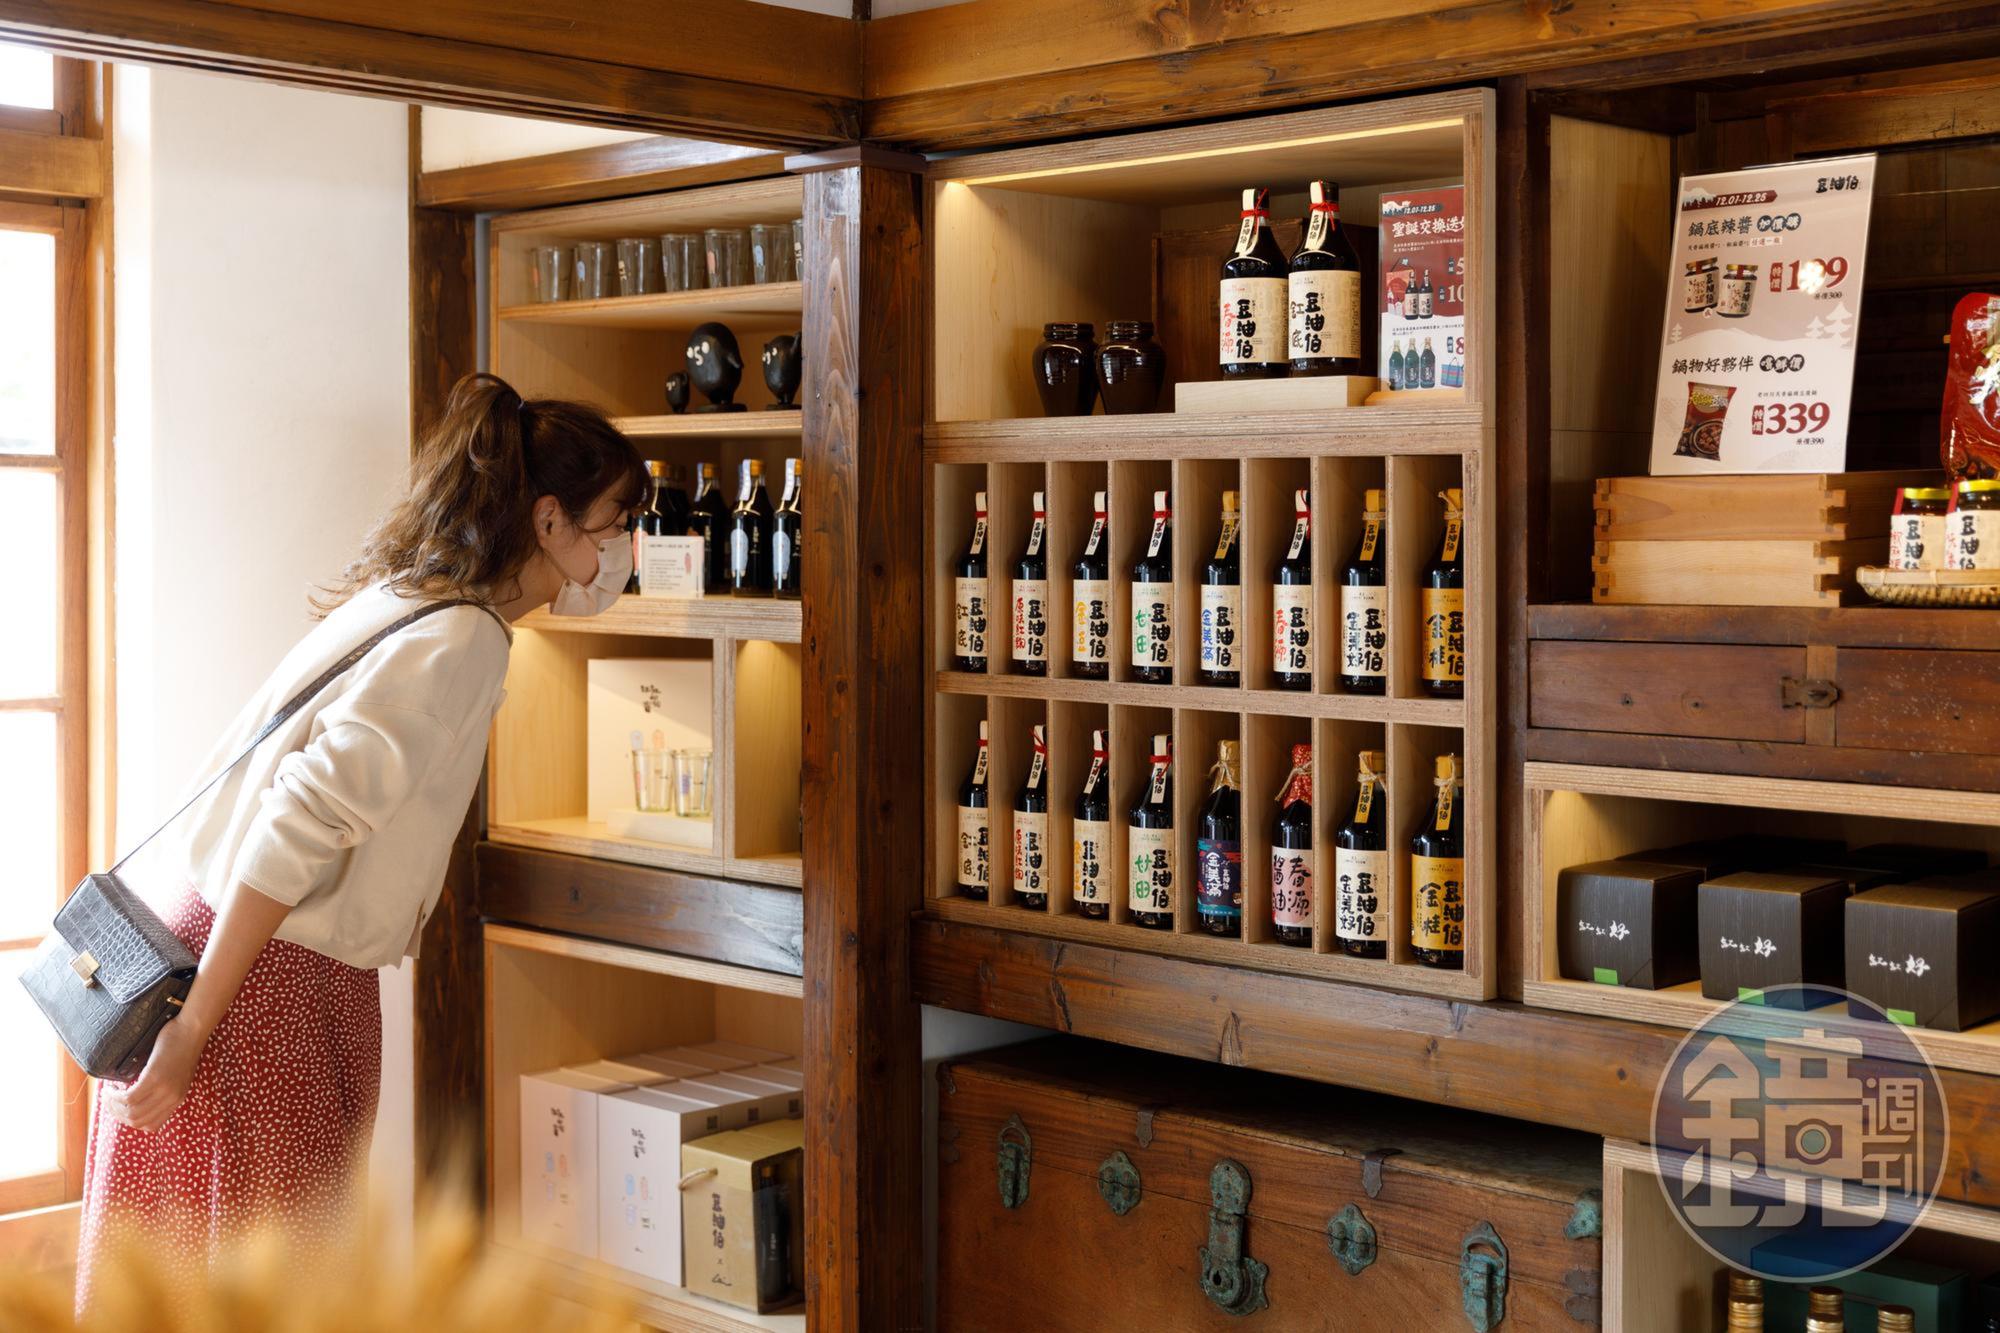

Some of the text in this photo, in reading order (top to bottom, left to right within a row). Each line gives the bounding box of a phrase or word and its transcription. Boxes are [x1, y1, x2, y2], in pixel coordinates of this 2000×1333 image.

[1715, 192, 1767, 206] 12.01-12.25
[1815, 175, 1859, 193] 豆油伯
[1688, 215, 1753, 237] 鍋底辣醬
[1236, 298, 1256, 359] 豆油伯
[1305, 292, 1325, 353] 豆油伯
[1671, 355, 1754, 375] 鍋物好夥伴
[1765, 402, 1830, 434] 339
[970, 597, 986, 653] 豆油伯
[1028, 600, 1046, 656] 豆油伯
[1090, 600, 1108, 658] 豆油伯
[1151, 603, 1170, 663] 豆油伯
[1216, 606, 1234, 667] 豆油伯
[1290, 606, 1310, 668] 豆油伯
[1364, 608, 1386, 672] 豆油伯
[1026, 832, 1042, 889] 豆油伯
[1082, 840, 1099, 898] 豆油伯
[1134, 854, 1152, 899] 甘田
[1152, 849, 1172, 908] 豆油伯
[1289, 855, 1311, 917] 春源
[1356, 872, 1378, 936] 豆油伯
[1420, 882, 1441, 937] 金桂
[1443, 880, 1464, 946] 豆油伯
